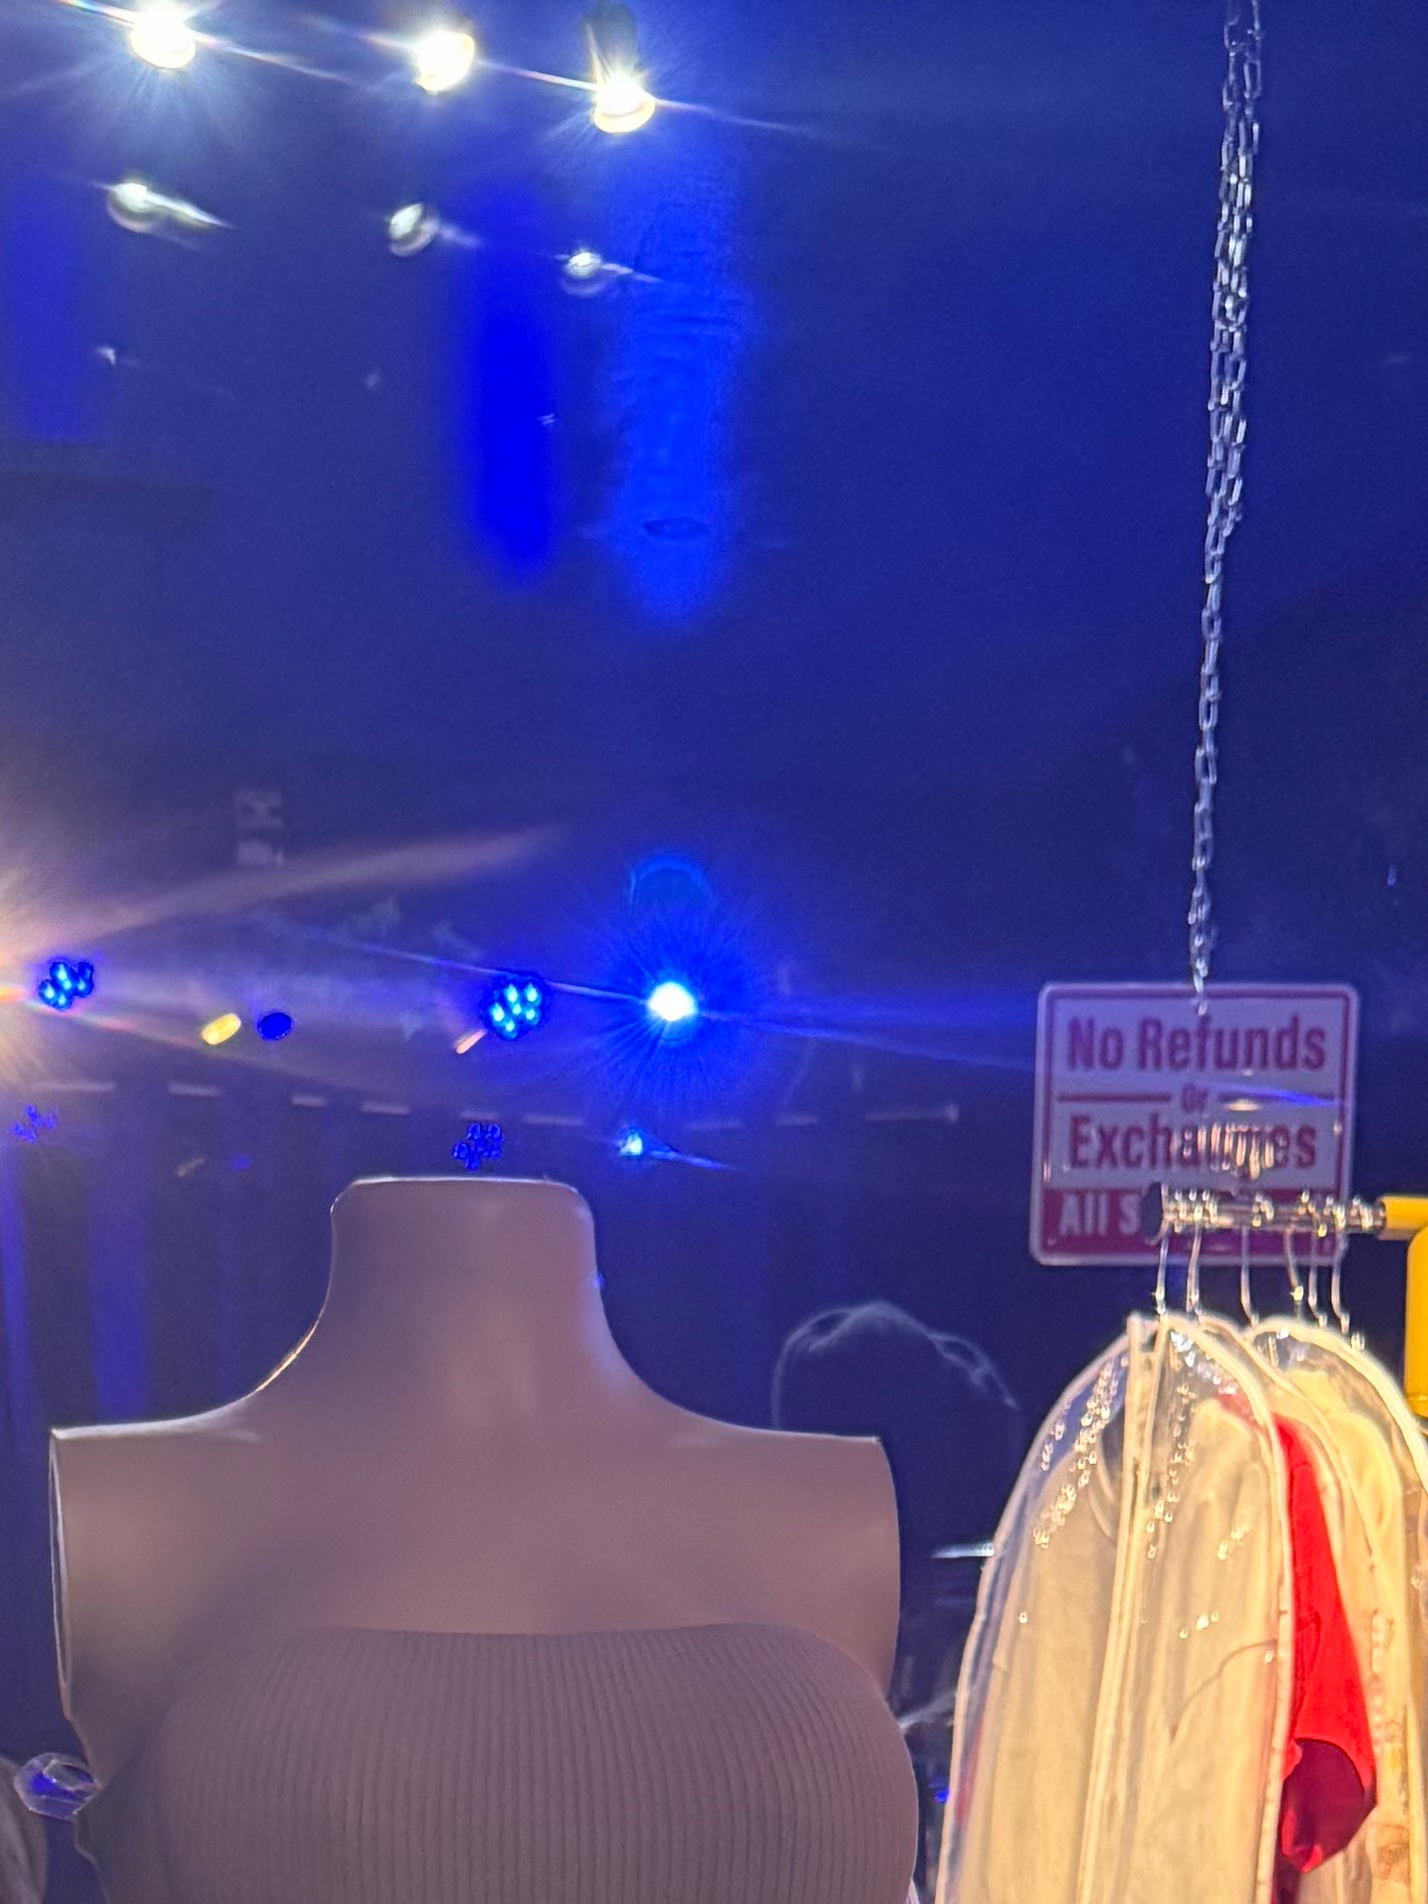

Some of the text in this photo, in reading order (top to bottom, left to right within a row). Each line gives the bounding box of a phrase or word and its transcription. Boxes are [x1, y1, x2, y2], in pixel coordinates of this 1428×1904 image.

[1067, 1014, 1327, 1071] No Refunds
[1059, 1193, 1108, 1237] All
